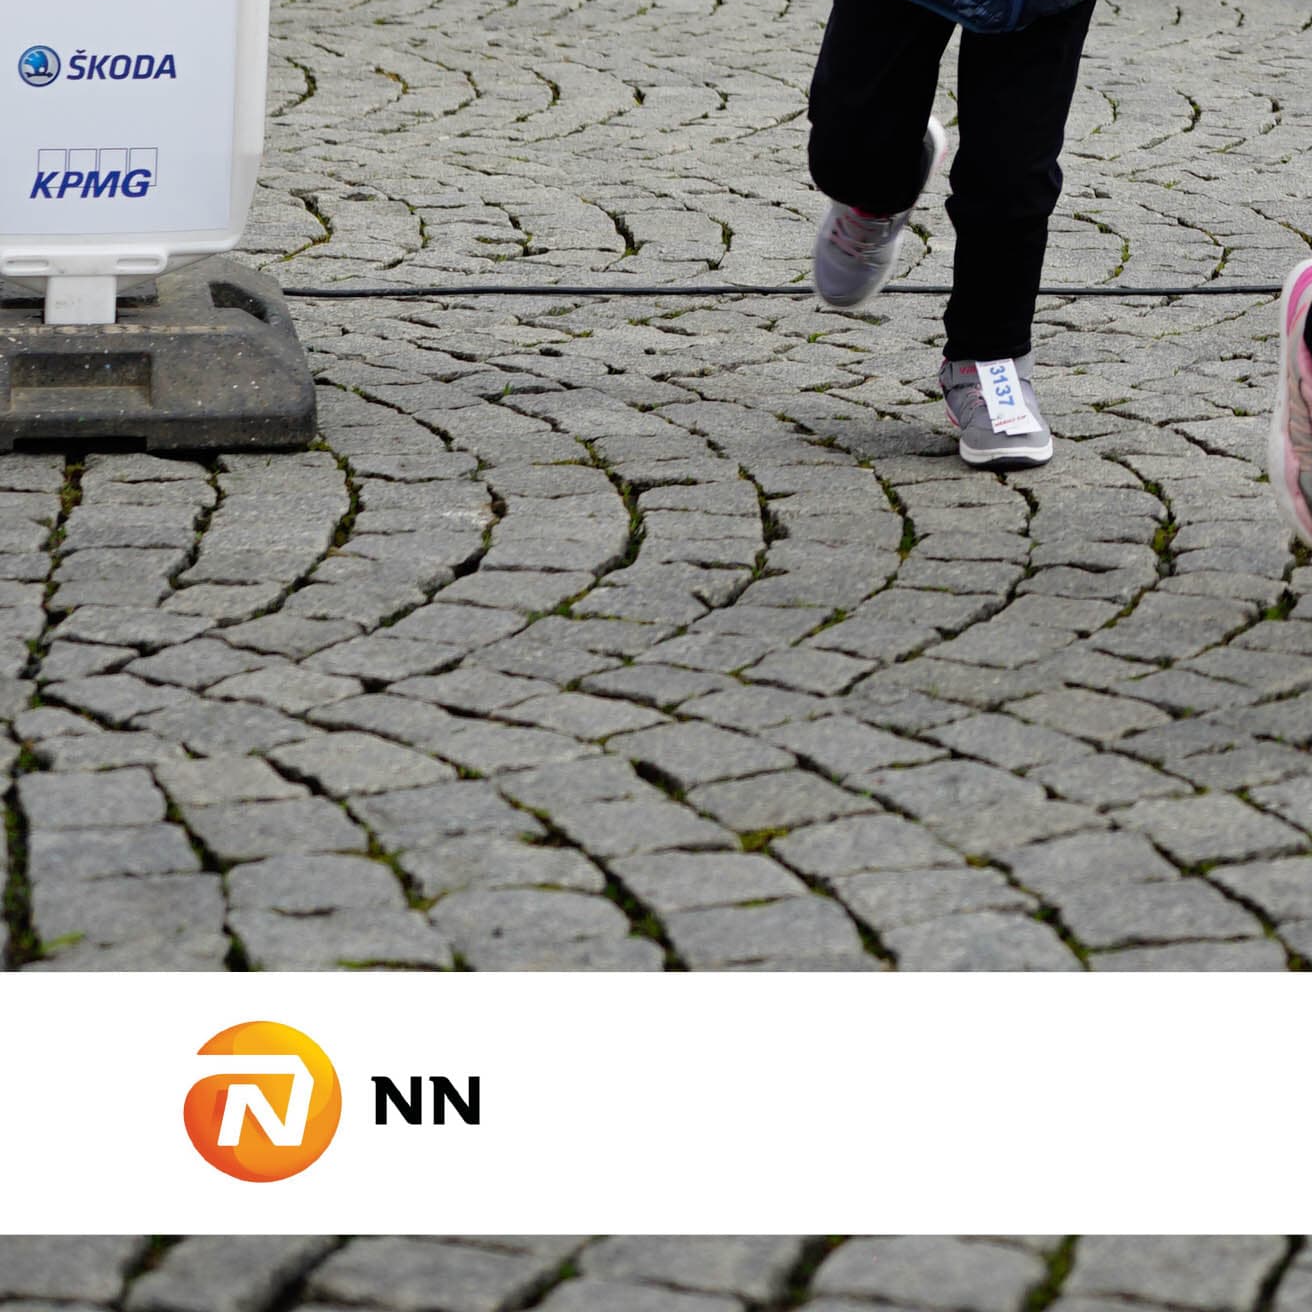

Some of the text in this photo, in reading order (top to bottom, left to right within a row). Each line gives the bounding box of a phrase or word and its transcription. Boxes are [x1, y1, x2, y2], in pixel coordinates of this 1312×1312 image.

[67, 50, 177, 80] ŠKODA
[29, 169, 153, 199] KPMG
[990, 366, 1015, 407] 3137
